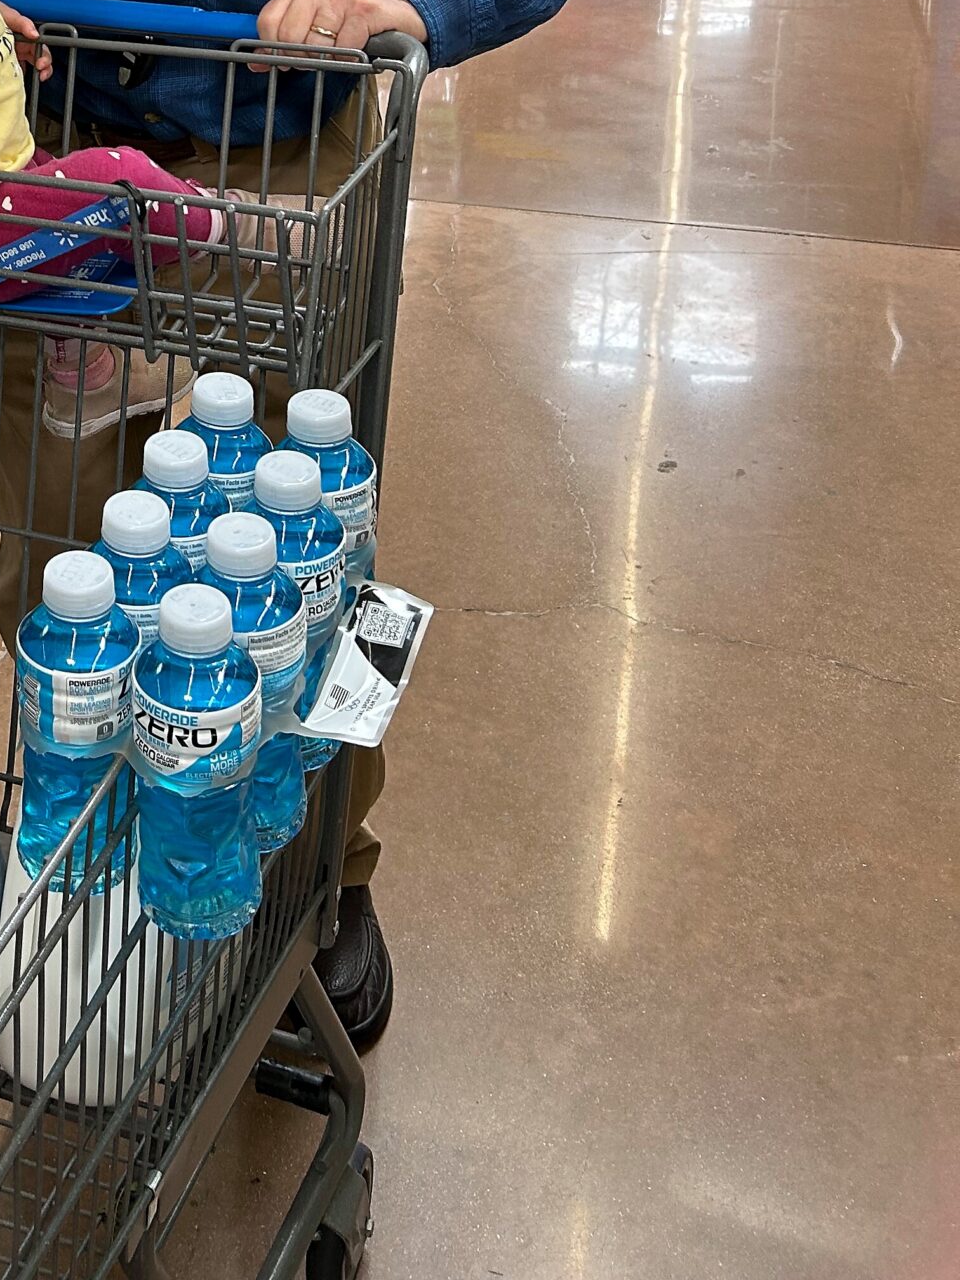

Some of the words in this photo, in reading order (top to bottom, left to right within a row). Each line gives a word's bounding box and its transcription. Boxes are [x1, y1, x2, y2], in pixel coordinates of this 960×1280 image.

[0, 246, 19, 264] seat
[18, 239, 36, 253] use
[18, 249, 47, 267] Please:
[68, 676, 111, 687] POWERADE
[116, 703, 132, 725] ZER
[133, 698, 218, 748] ZERO
[134, 733, 156, 761] ZERO
[210, 757, 239, 773] MORE
